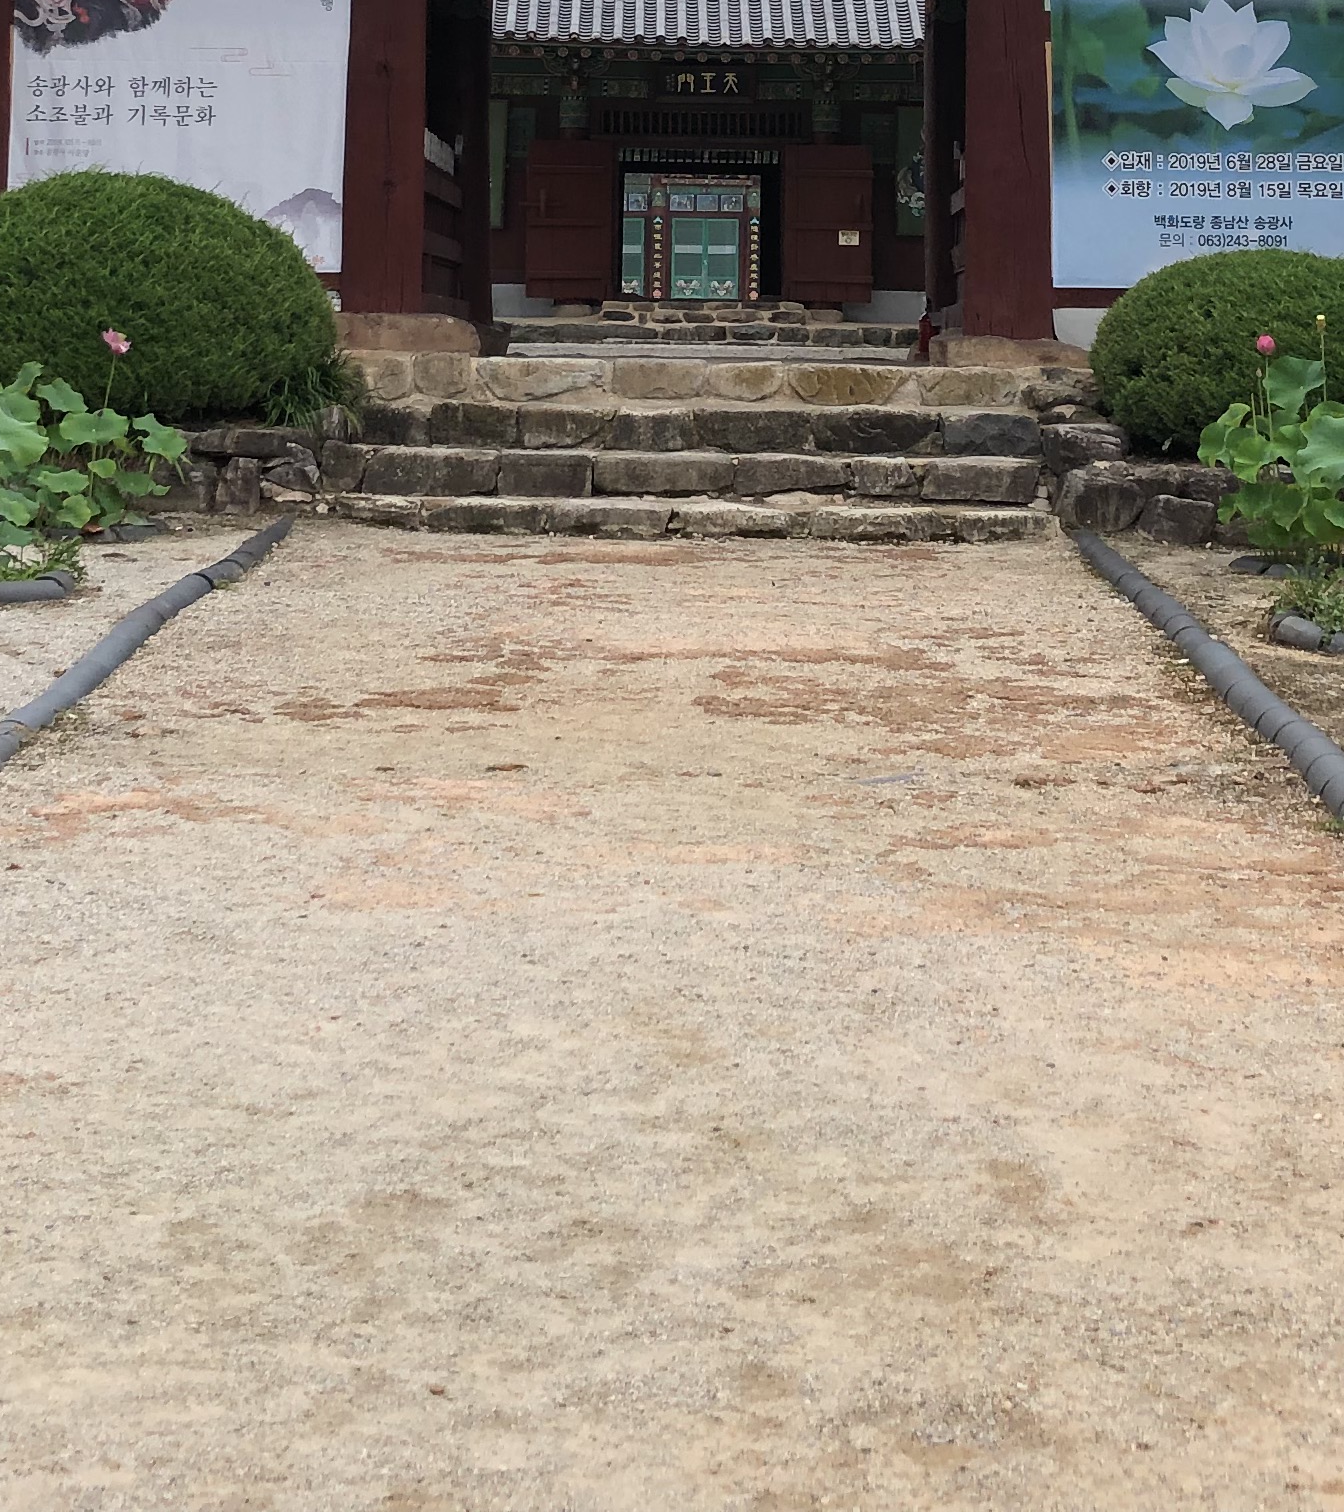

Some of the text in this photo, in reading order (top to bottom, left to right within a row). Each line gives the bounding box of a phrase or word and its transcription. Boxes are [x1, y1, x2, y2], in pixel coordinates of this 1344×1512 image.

[26, 74, 218, 98] 송광사와 함께하는
[25, 103, 217, 127] 소조불과 기록문화
[1120, 153, 1151, 170] 입재
[1168, 153, 1221, 170] 2019년
[1226, 153, 1252, 171] 6월
[1256, 154, 1292, 171] 28일
[1296, 153, 1344, 171] 금요일
[1120, 181, 1151, 197] 회향
[1169, 181, 1221, 198] 2019년
[1226, 181, 1252, 198] 8월
[1259, 182, 1292, 199] 15일
[1297, 182, 1344, 199] 목요일
[1154, 214, 1293, 230] 백화도량 종남산 송광사
[1158, 233, 1185, 247] 문의
[1197, 233, 1288, 248] 063)243-8091
